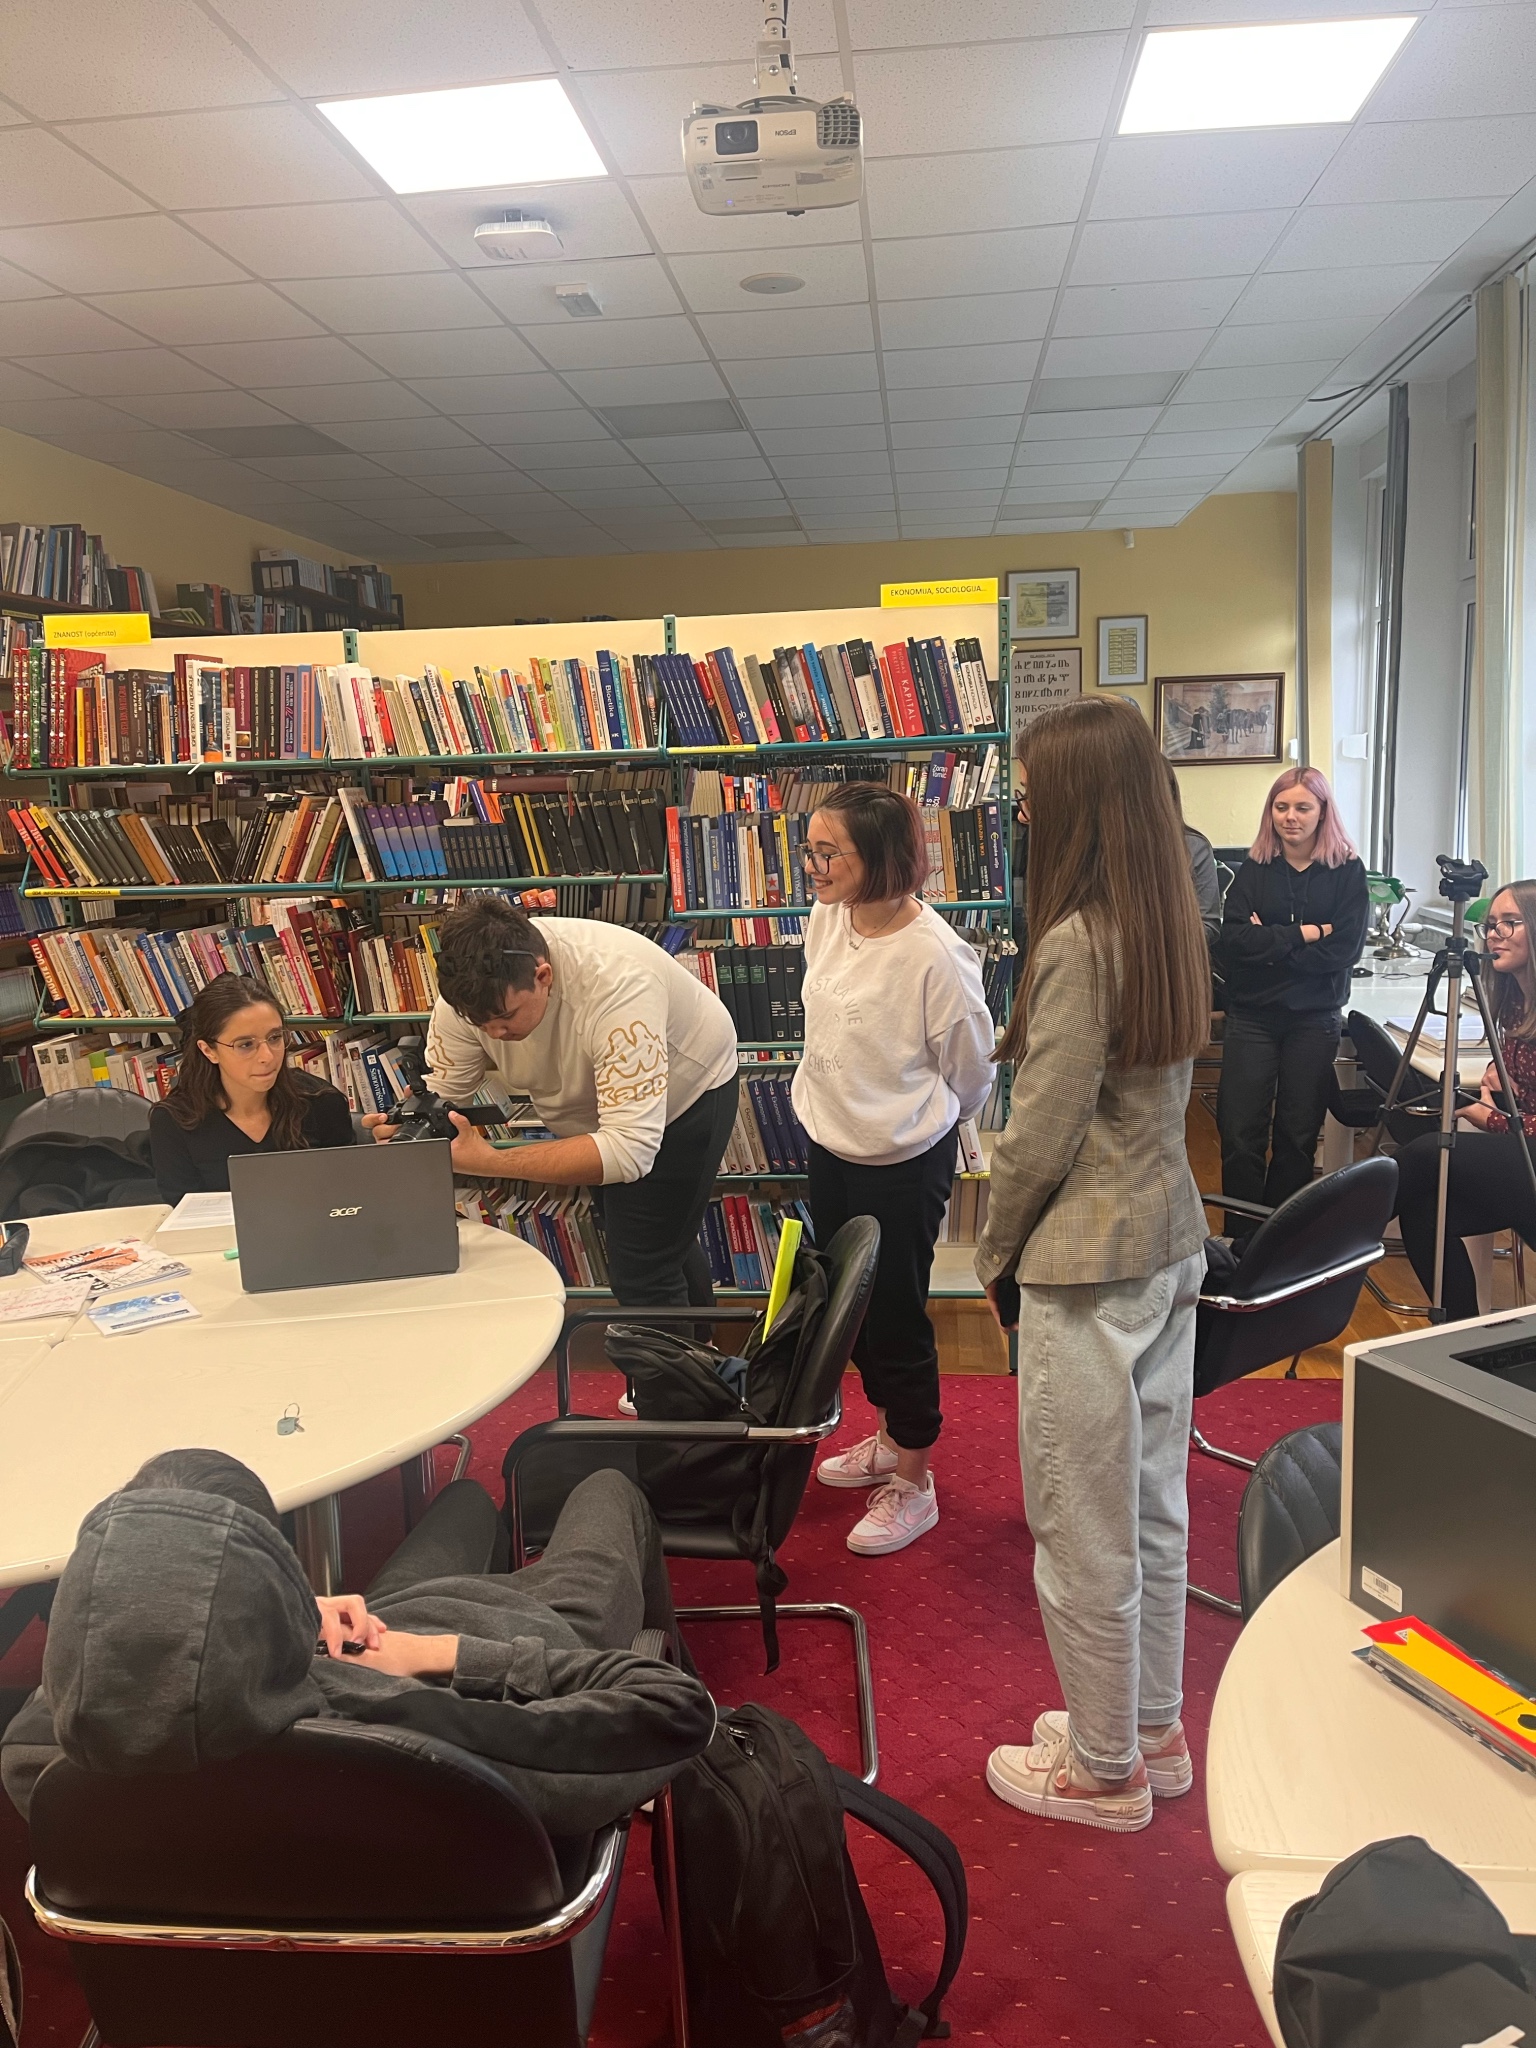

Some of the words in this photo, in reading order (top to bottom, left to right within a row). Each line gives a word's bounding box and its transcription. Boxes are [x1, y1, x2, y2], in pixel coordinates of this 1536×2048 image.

[774, 128, 797, 137] EPSON
[890, 587, 934, 597] EKONOMIJA,
[891, 650, 901, 675] PIKETTY
[896, 648, 906, 674] THOMAS
[604, 684, 616, 718] Bioetika
[901, 679, 917, 721] KAPITAL
[285, 706, 294, 719] 70
[932, 763, 948, 772] Zoran
[932, 770, 947, 779] Tomić
[794, 879, 803, 903] EUROPSKA
[31, 942, 46, 966] UČITI
[188, 960, 201, 983] digitalno
[833, 980, 850, 1001] LA
[844, 998, 863, 1026] VIE
[808, 1052, 843, 1074] CHÉRIE
[754, 1095, 769, 1126] Ekonomija
[770, 1095, 785, 1126] Ekonomija
[743, 1107, 758, 1140] Ekonomija
[329, 1204, 363, 1218] acer
